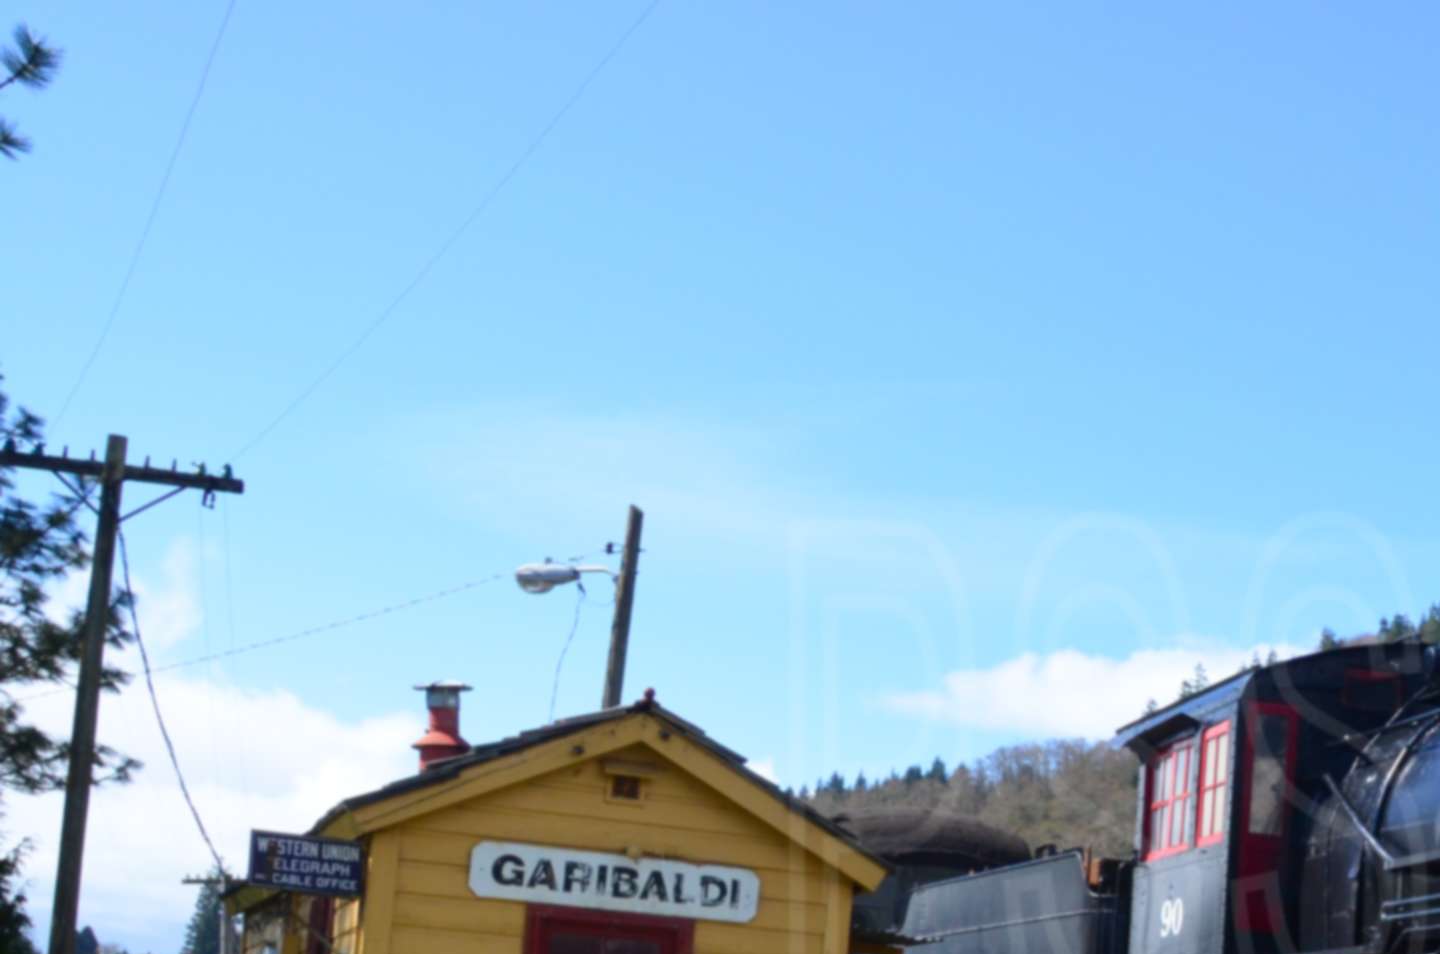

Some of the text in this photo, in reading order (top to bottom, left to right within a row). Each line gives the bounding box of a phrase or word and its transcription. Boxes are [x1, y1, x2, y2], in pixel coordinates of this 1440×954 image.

[257, 836, 319, 857] WSTERN
[266, 857, 351, 876] ELEGRAPH
[272, 872, 313, 888] CABLE
[315, 877, 359, 891] OFFICE
[491, 854, 742, 909] GARIBALDI
[1160, 897, 1184, 938] 90
